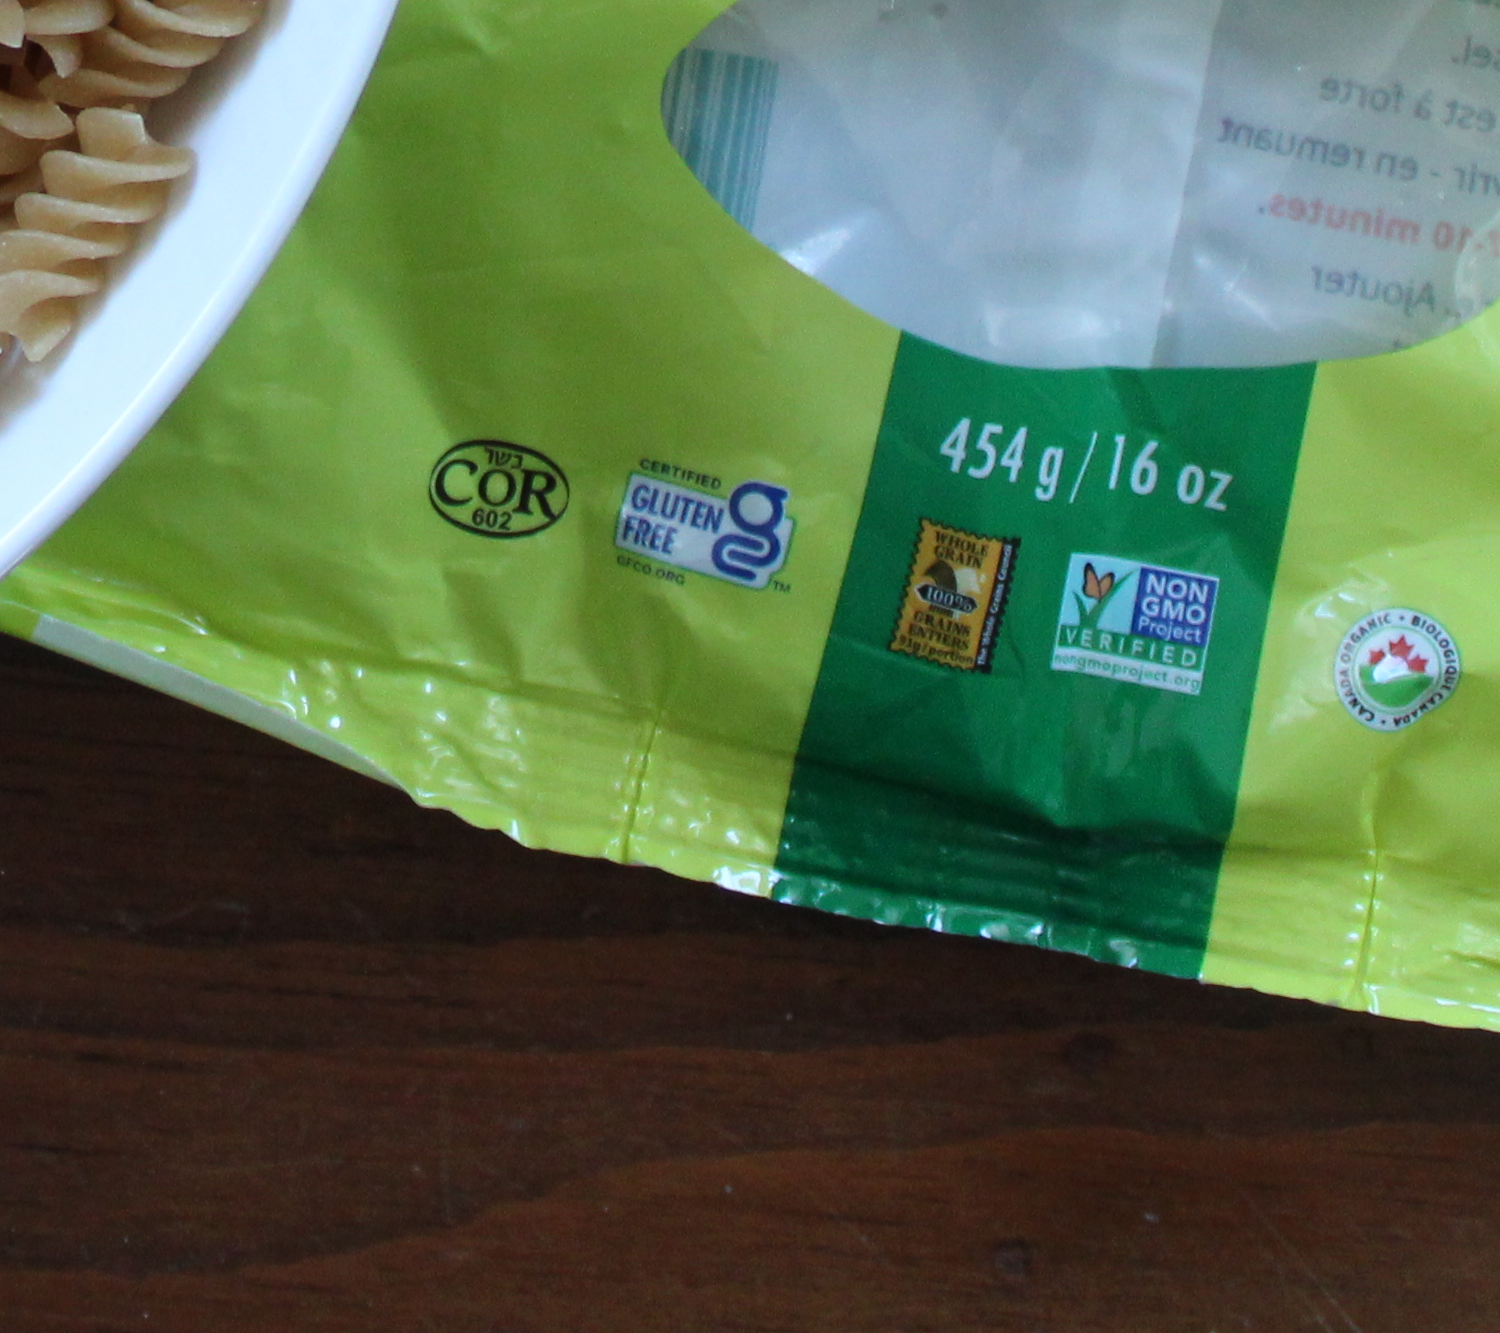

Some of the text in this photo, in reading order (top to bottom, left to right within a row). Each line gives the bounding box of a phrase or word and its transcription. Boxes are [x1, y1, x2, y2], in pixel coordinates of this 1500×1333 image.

[435, 458, 557, 521] COR
[639, 458, 722, 490] CERTIFIED
[1176, 464, 1234, 512] oz
[472, 508, 512, 531] 602
[631, 483, 725, 534] GLUTEN
[622, 514, 678, 555] FREE
[935, 530, 989, 557] WHOLE
[934, 545, 984, 570] GRAIN
[926, 585, 973, 613] 100%
[1145, 572, 1210, 604] NON
[1141, 595, 1207, 626] GMO
[1137, 615, 1203, 643] Project
[1066, 627, 1198, 668] VERIFIED
[1054, 653, 1201, 694] nongmoproject.org
